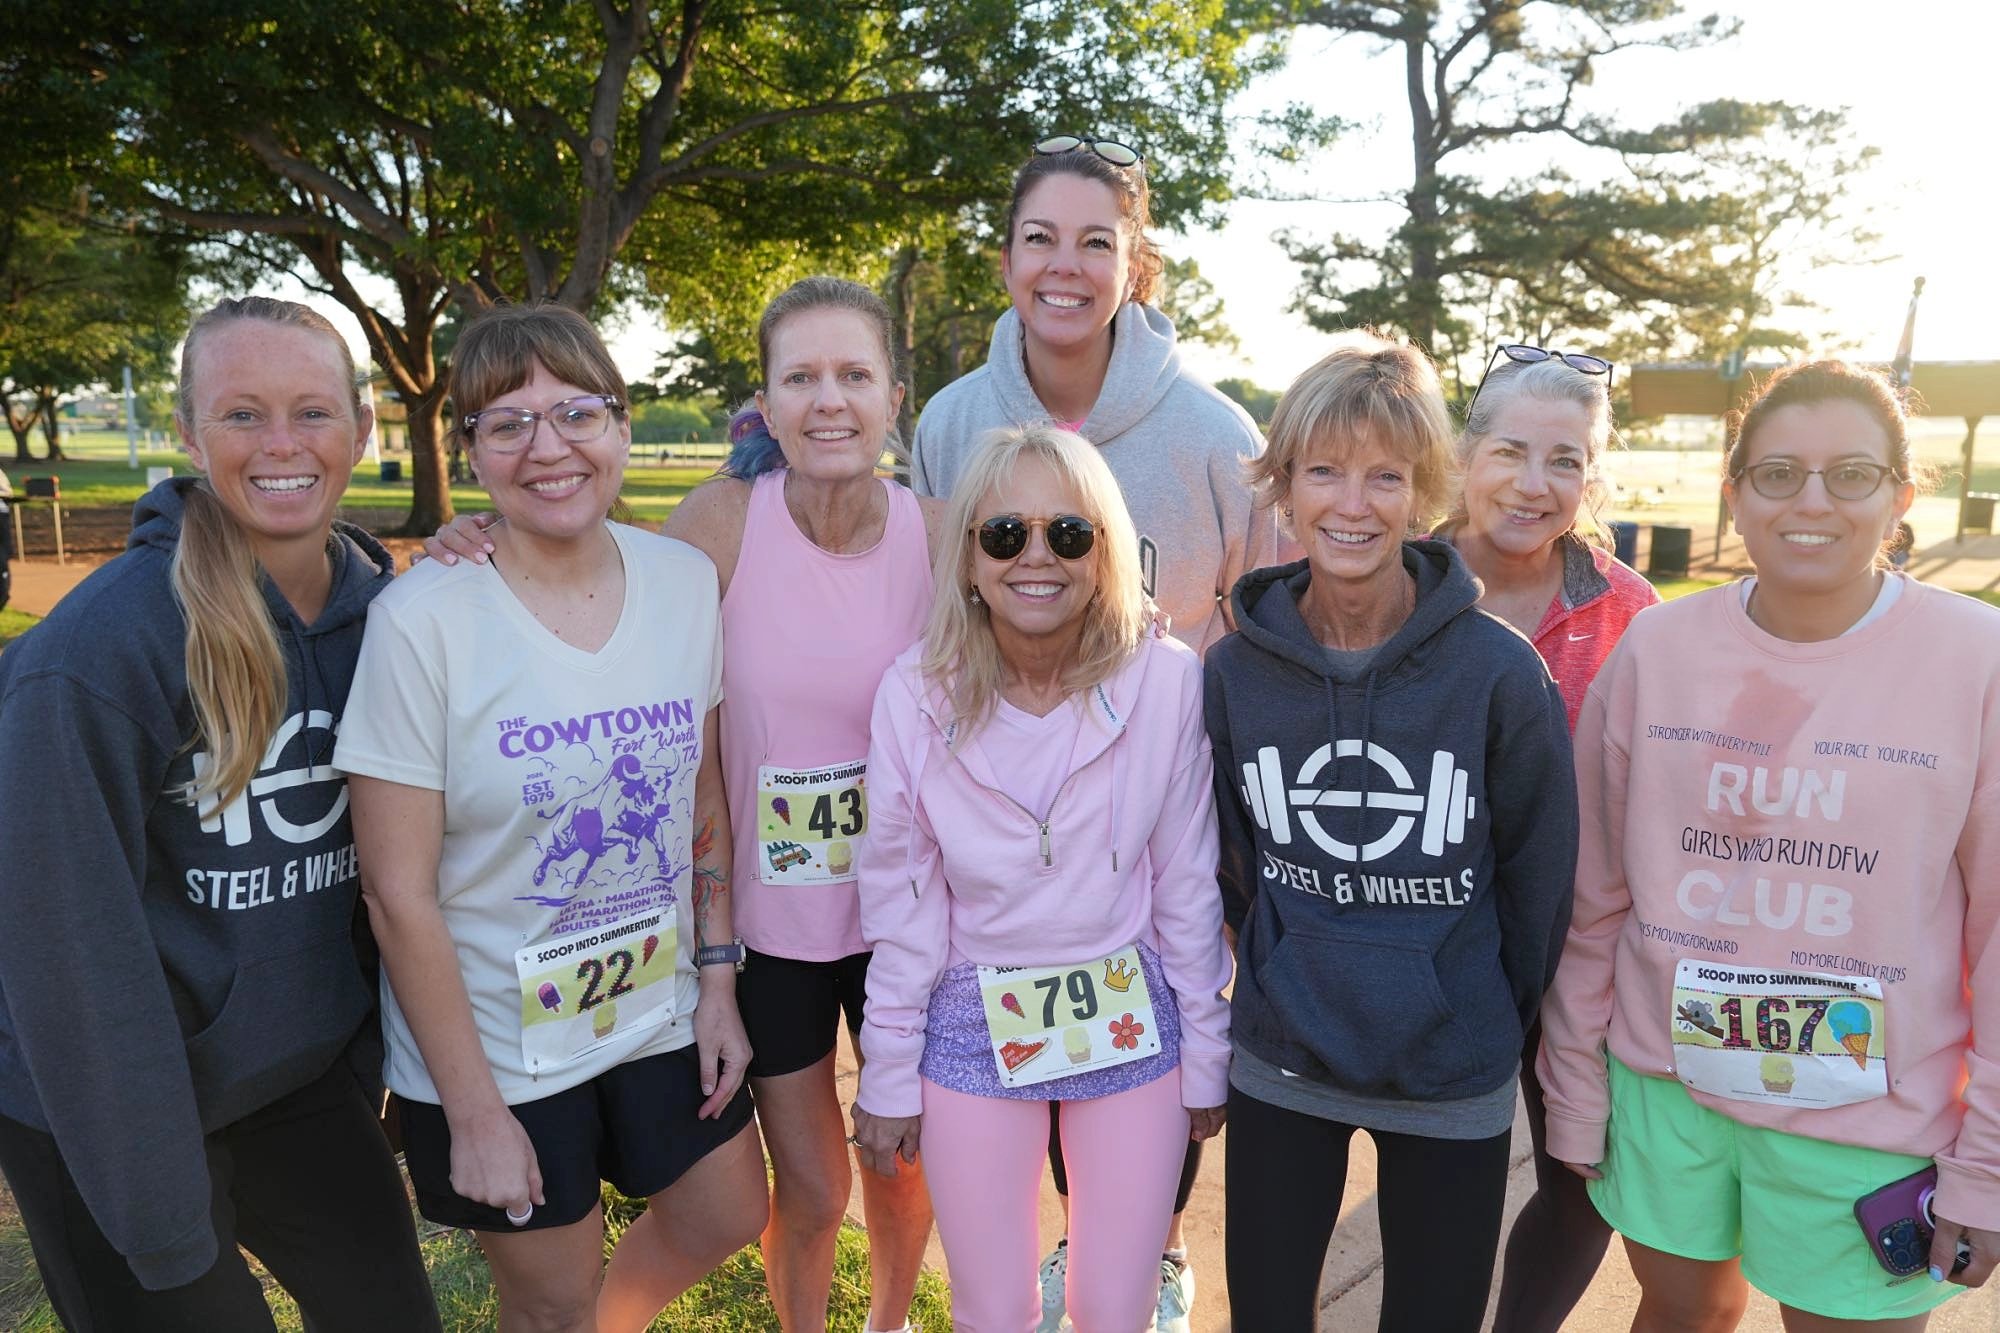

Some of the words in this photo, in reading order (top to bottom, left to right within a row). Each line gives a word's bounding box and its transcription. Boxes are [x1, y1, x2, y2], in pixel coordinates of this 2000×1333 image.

[496, 716, 529, 733] THE
[498, 697, 695, 759] COWTOWN
[1647, 724, 1692, 741] STRONGER
[1692, 728, 1717, 745] WITH
[1716, 733, 1749, 753] EVERY
[1747, 741, 1773, 756] MILE
[611, 734, 647, 756] Fort
[682, 742, 699, 764] TX
[1814, 741, 1842, 756] YOUR
[1843, 742, 1869, 759] PACE
[1877, 746, 1909, 764] YOUR
[1910, 751, 1939, 770] RACE
[774, 774, 808, 785] SCOOP
[809, 772, 832, 785] INTO
[1707, 761, 1848, 822] RUN
[522, 790, 555, 806] 1979
[808, 788, 864, 840] 43
[1681, 826, 1733, 860] GIRLS
[1777, 838, 1824, 867] RUN
[1827, 843, 1880, 875] DFW
[186, 866, 275, 910] STEEL
[282, 859, 299, 899] &
[1263, 850, 1332, 899] STEEL
[1333, 873, 1354, 904] &
[1360, 868, 1475, 906] WHEELS
[549, 911, 578, 929] HALF
[581, 896, 652, 919] MARATHON
[560, 898, 595, 917] ULTRA
[605, 883, 673, 905] MARATHON
[1676, 869, 1855, 937] CLUB
[537, 944, 575, 964] SCOOP
[576, 935, 599, 953] INTO
[600, 914, 661, 944] SUMMERTIME
[552, 918, 600, 936] ADULTS
[1652, 925, 1690, 947] MOVING
[1690, 934, 1739, 955] FORWARD
[576, 949, 636, 1014] 22
[1697, 967, 1735, 983] SCOOP
[1737, 973, 1768, 985] INTO
[1769, 973, 1858, 992] SUMMERTIME
[1790, 950, 1807, 966] NO
[1808, 953, 1840, 969] MORE
[1840, 956, 1880, 978] LONELY
[1880, 965, 1907, 981] RUNS
[1034, 969, 1099, 1029] 79
[1720, 998, 1831, 1053] 167
